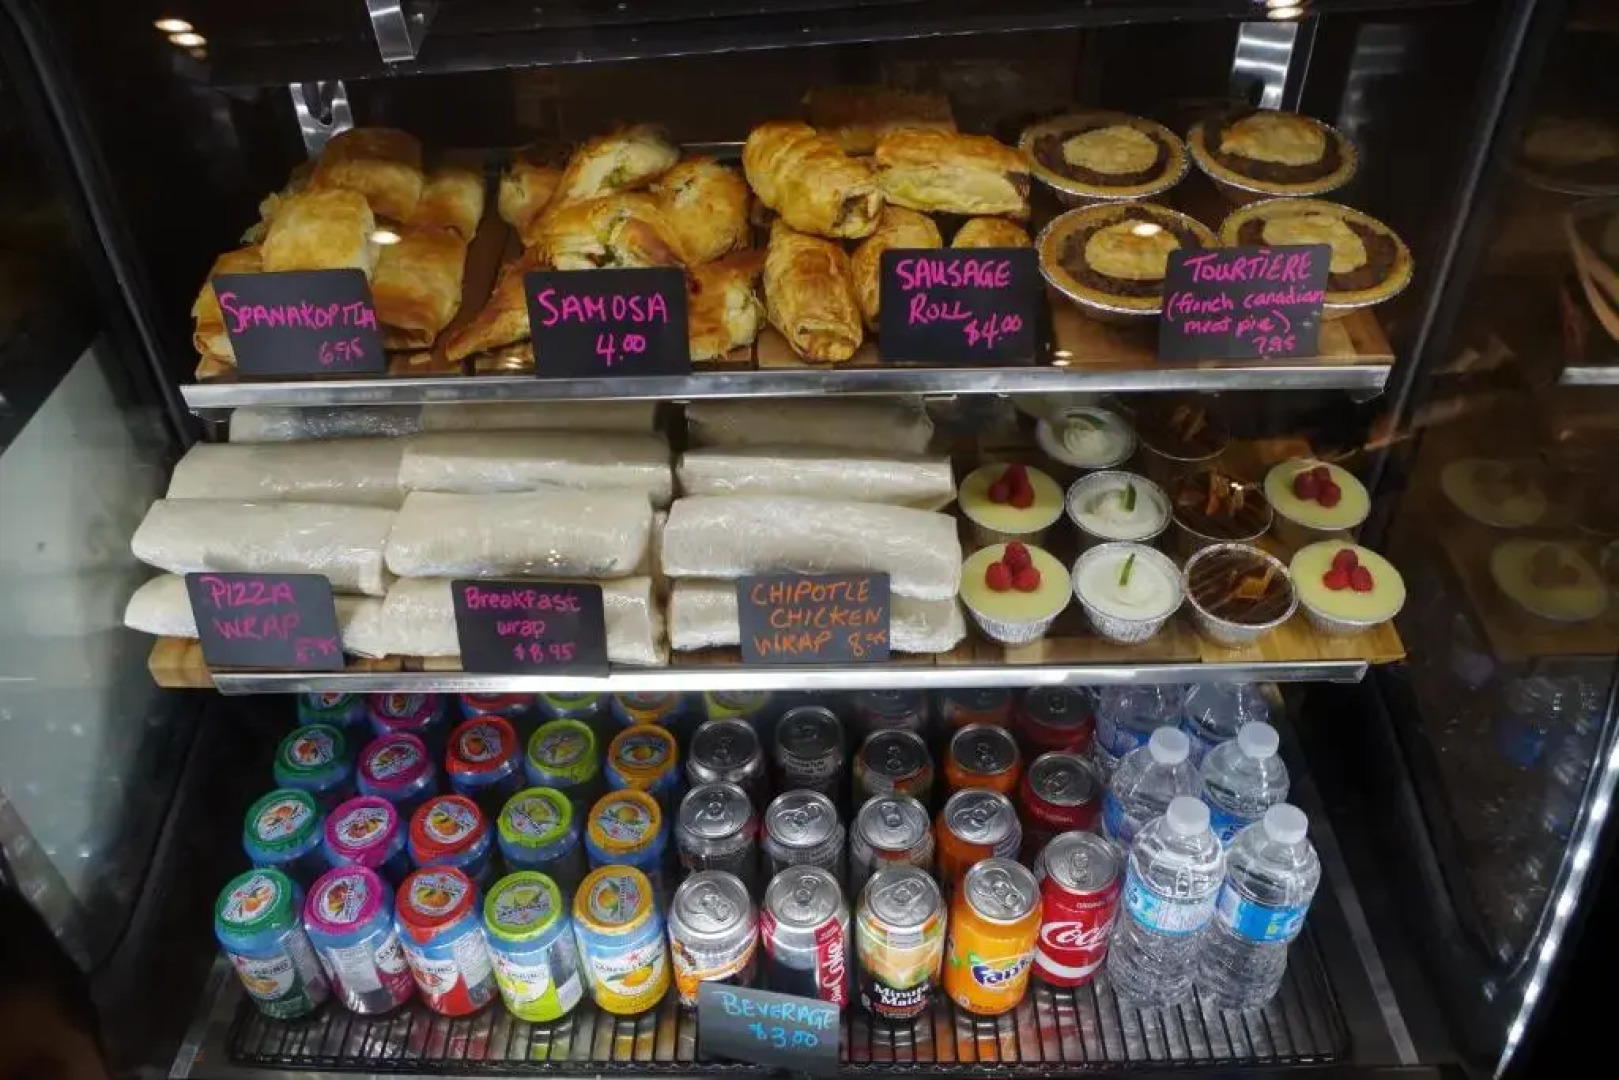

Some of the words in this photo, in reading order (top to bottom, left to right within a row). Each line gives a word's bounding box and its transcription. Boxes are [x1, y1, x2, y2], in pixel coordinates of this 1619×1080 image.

[896, 257, 1011, 291] SAUSAGE
[536, 287, 668, 328] SAMOSA
[963, 312, 1023, 349] $4.00
[595, 333, 646, 368] 4.00
[200, 575, 297, 609] PIZZA
[751, 578, 871, 606] CHIPOTLE
[212, 613, 300, 641] WRAP
[497, 619, 546, 640] wrap
[770, 604, 884, 630] CHICKEN
[753, 630, 834, 657] WRAP
[711, 990, 836, 1031] BEVERAGE
